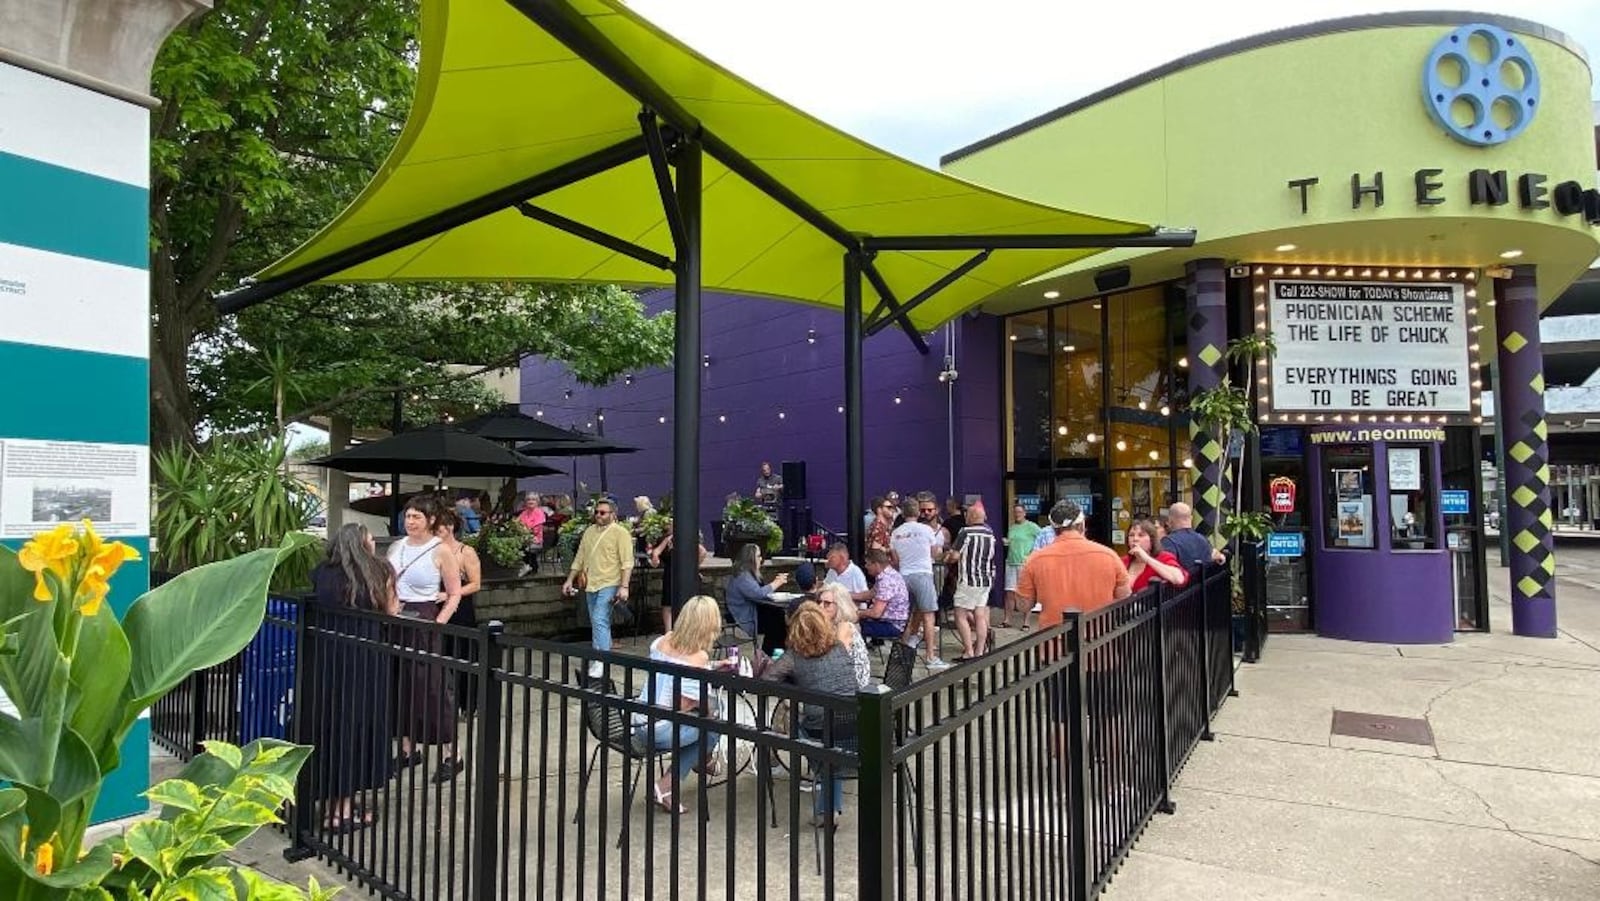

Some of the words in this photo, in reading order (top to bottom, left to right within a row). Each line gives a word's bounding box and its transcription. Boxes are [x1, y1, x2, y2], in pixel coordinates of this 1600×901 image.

[1288, 168, 1446, 214] THE
[1280, 285, 1297, 297] Call
[1300, 286, 1347, 298] 222-SHOW
[1348, 287, 1361, 298] for
[1363, 287, 1399, 299] TODAY's
[1401, 288, 1449, 300] Showtimes
[1285, 303, 1383, 321] PHOENICIAN
[1393, 306, 1454, 323] SCHEME
[1287, 324, 1319, 342] THE
[1329, 325, 1361, 342] LIFE
[1371, 326, 1389, 343] OF
[1400, 327, 1449, 344] CHUCK
[1286, 367, 1396, 385] EVERYTHINGS
[1411, 369, 1457, 386] GOING
[1311, 390, 1331, 406] TO
[1351, 390, 1370, 406] BE
[1387, 390, 1438, 407] GREAT
